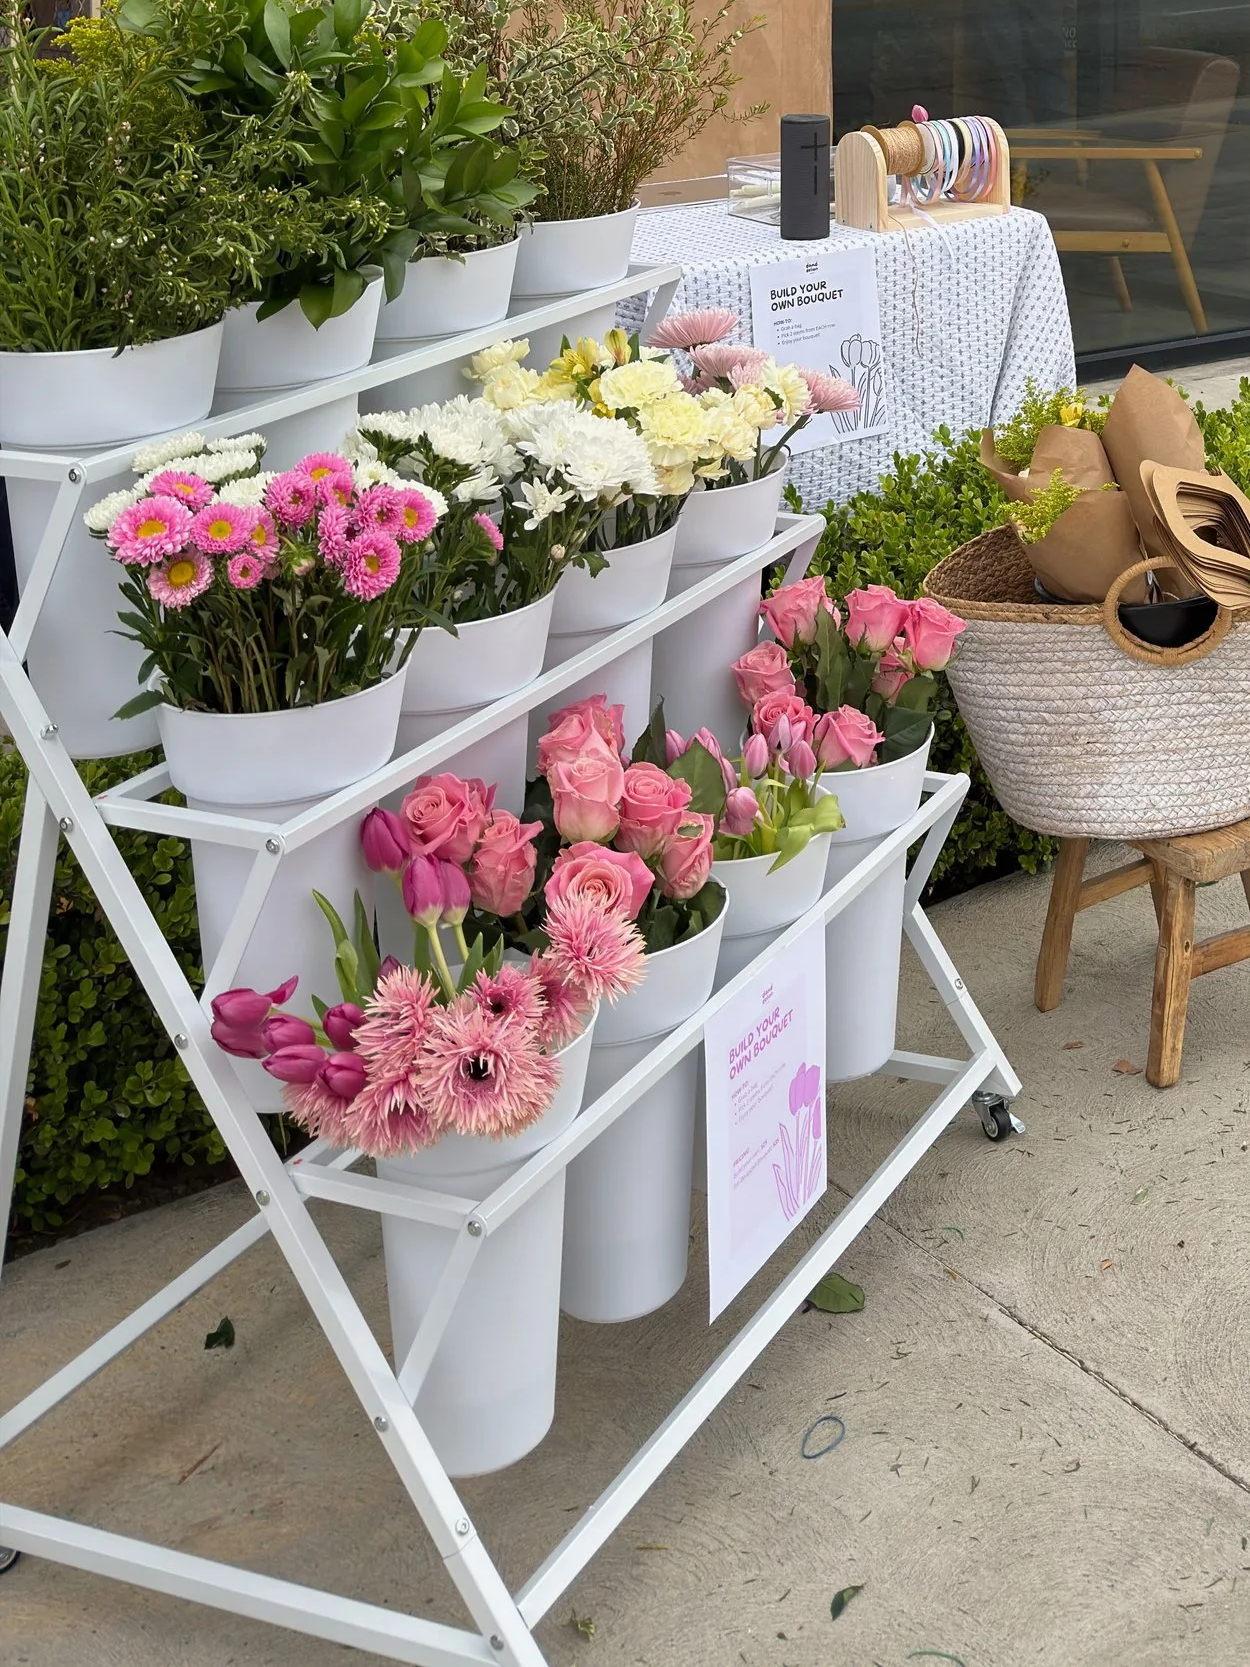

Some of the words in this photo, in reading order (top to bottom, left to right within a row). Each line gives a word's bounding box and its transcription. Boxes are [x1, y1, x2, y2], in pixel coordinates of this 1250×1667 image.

[770, 287, 797, 300] BUILD
[800, 281, 827, 294] YOUR
[771, 298, 795, 312] OWN
[796, 289, 844, 307] BOUQUET
[729, 1032, 754, 1065] BUILD
[756, 1006, 780, 1038] YOUR
[729, 1049, 752, 1080] OWN
[753, 1008, 794, 1058] BOUQUET
